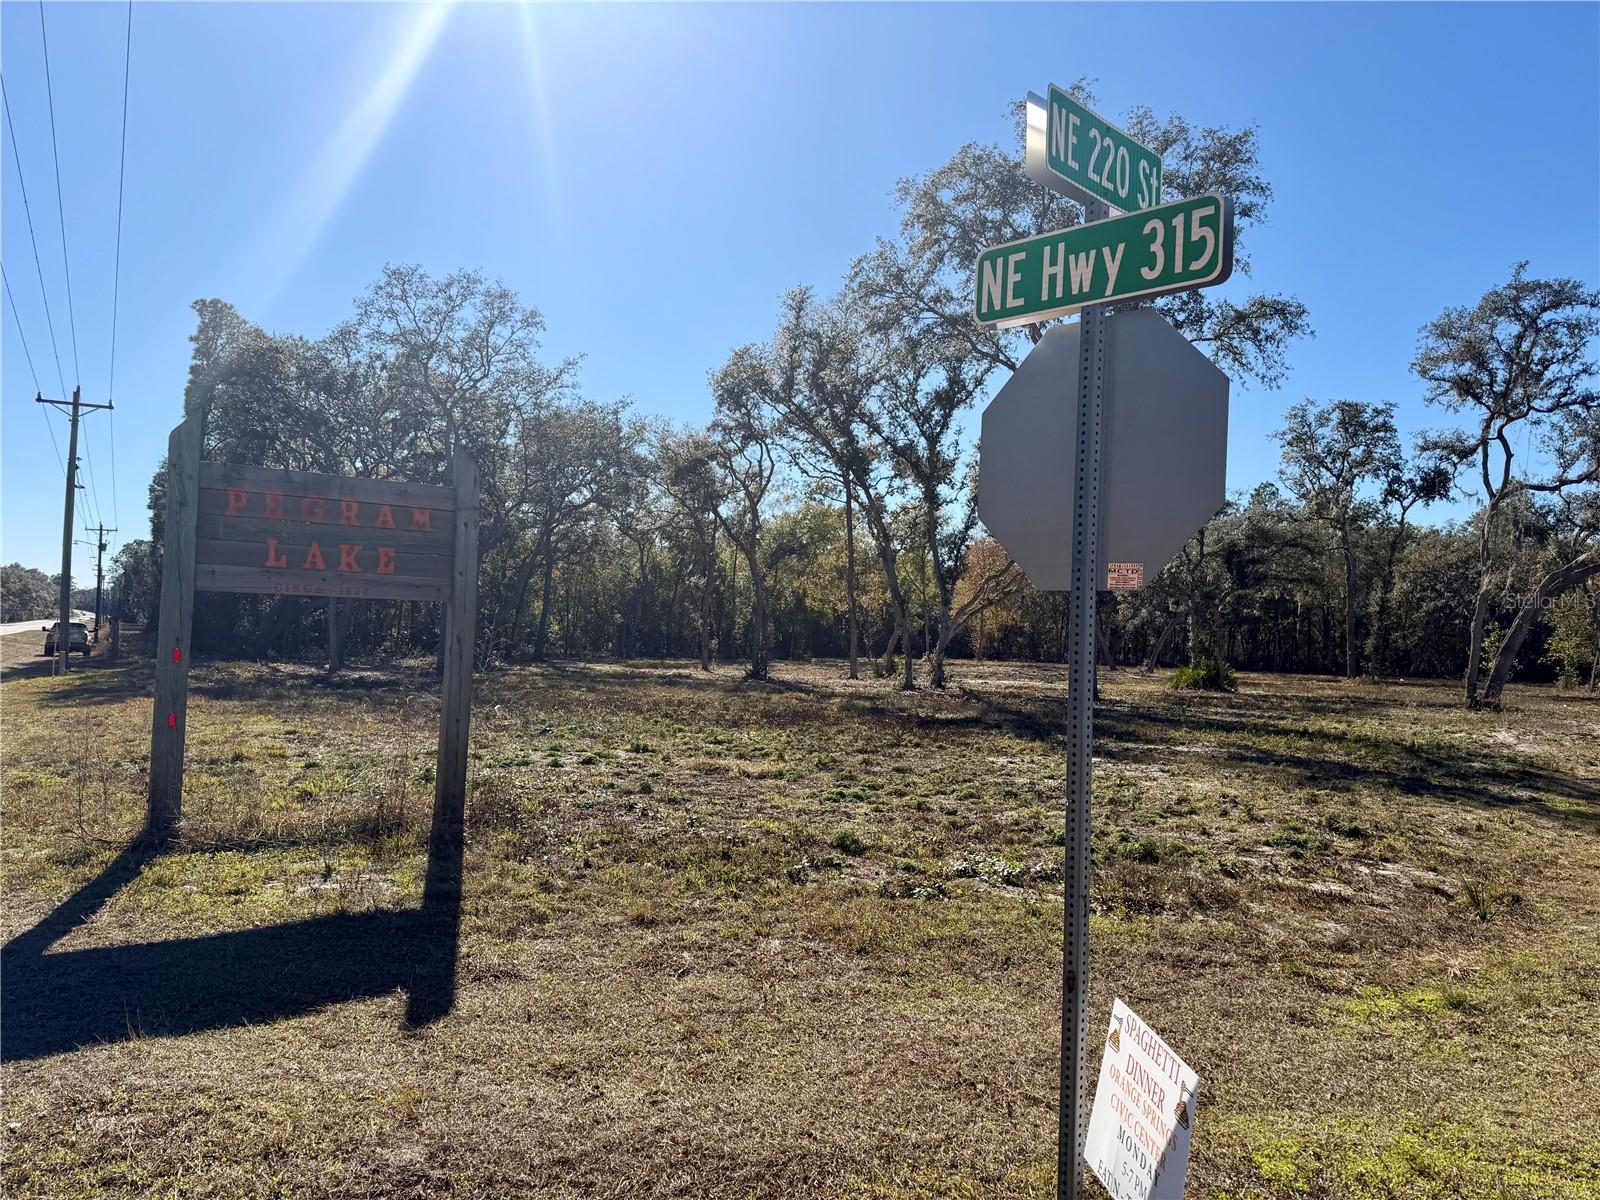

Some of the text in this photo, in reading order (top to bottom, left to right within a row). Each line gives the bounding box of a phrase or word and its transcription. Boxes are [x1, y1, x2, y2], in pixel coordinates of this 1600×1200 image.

[1052, 103, 1158, 209] NE 220 St
[981, 206, 1215, 313] NE Hwy 315
[224, 488, 432, 532] PEGRAM
[265, 539, 396, 574] LAKE
[1124, 1013, 1182, 1086] SPAGHETTI
[1126, 1053, 1166, 1114] DINNER
[1109, 1063, 1178, 1151] ORANGE SPRINGS
[1110, 1093, 1167, 1171] CIVIC CENTER
[1117, 1124, 1160, 1187] MONDAY
[1122, 1161, 1134, 1183] 5-7
[1134, 1175, 1148, 1200] PM
